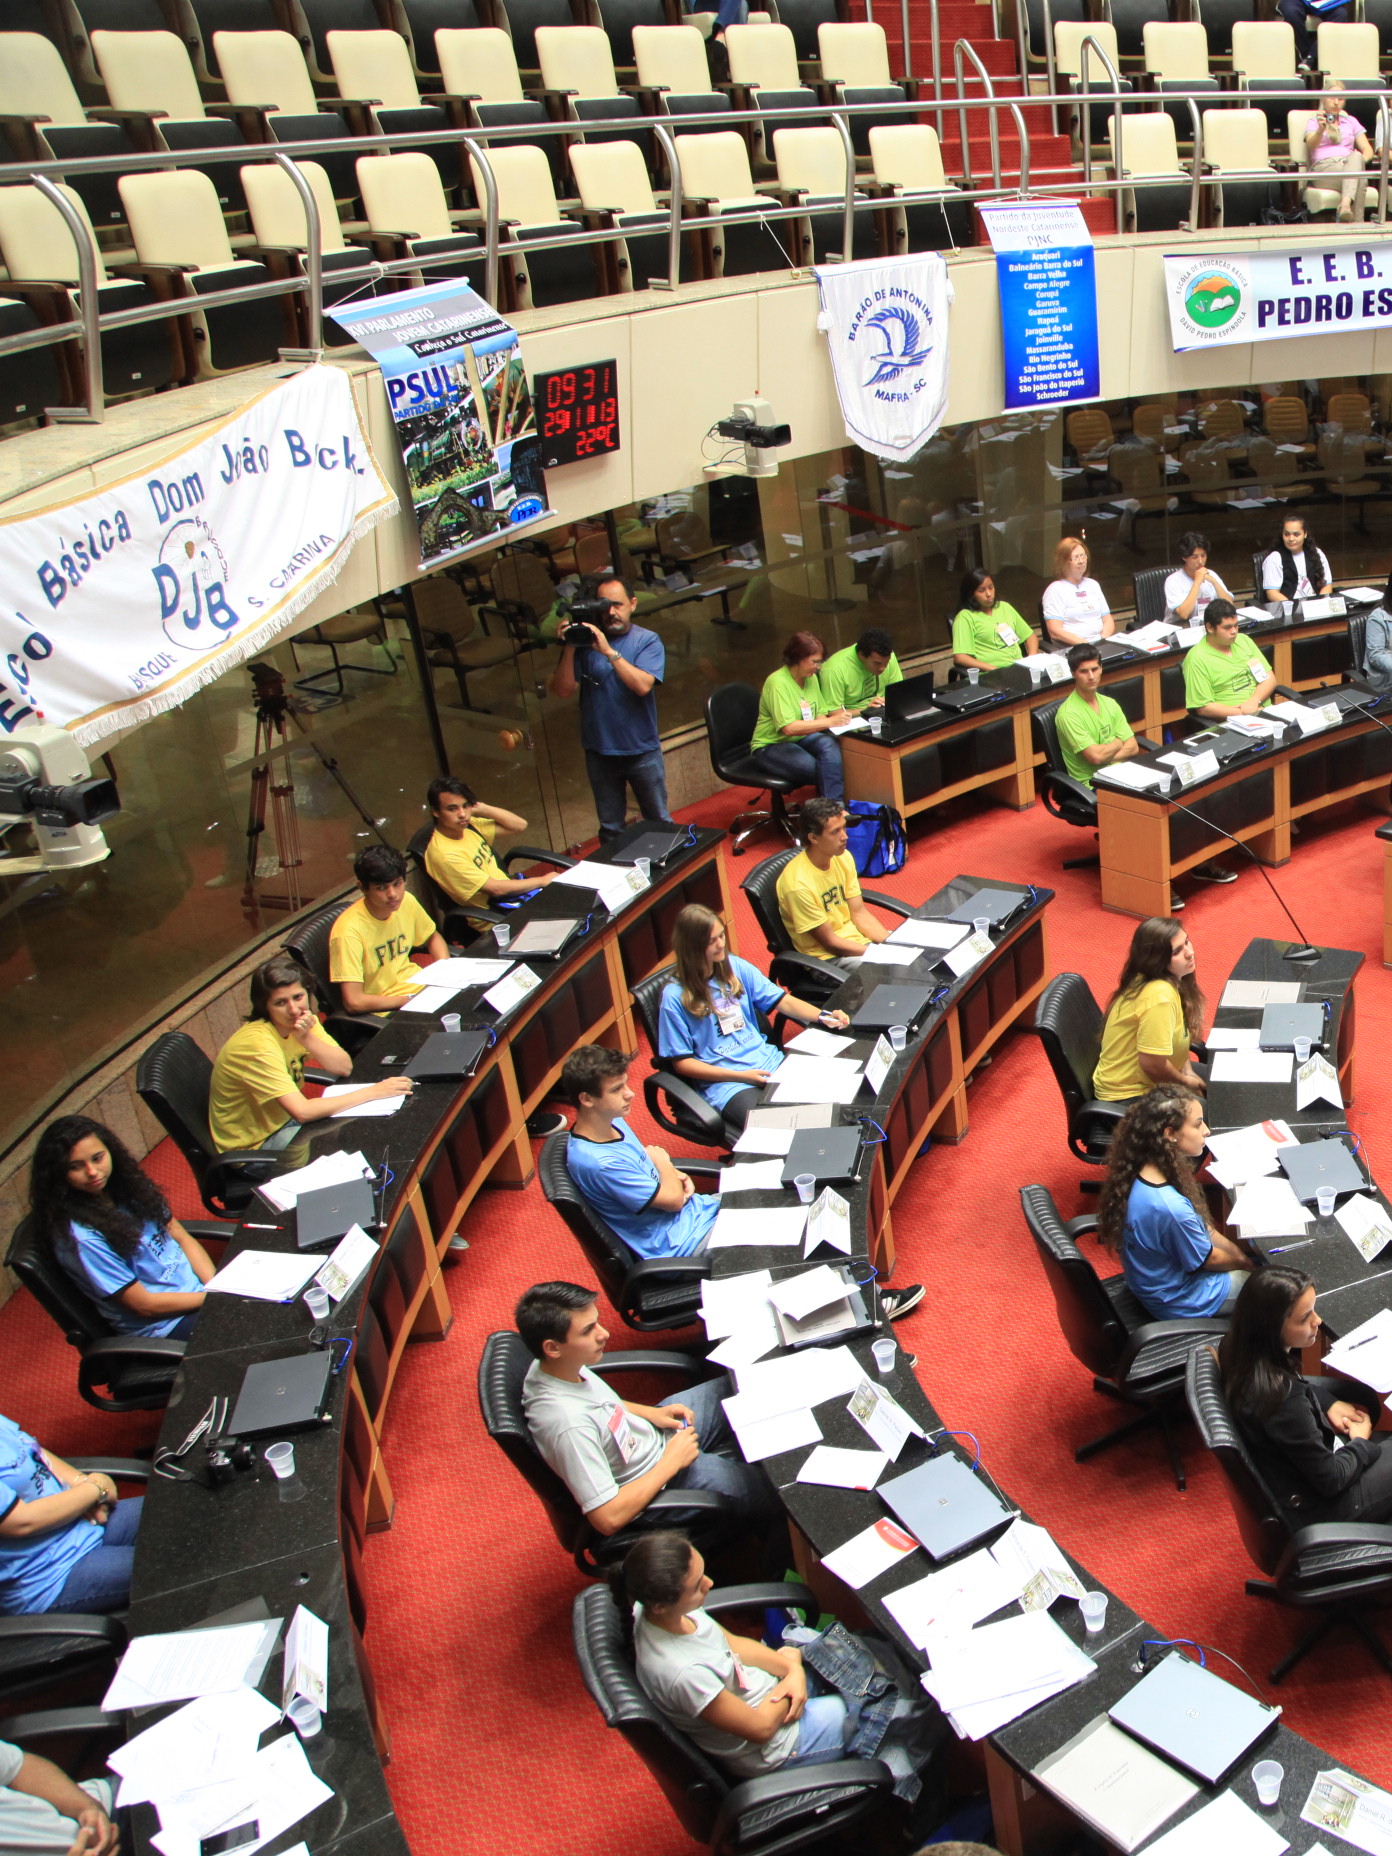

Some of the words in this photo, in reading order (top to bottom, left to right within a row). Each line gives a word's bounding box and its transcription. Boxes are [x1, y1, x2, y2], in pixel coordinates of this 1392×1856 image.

[989, 212, 1019, 222] Partido
[1021, 211, 1031, 220] da
[1033, 210, 1074, 221] Juventude
[992, 224, 1029, 234] Nordeste
[1031, 221, 1079, 232] Catarinense
[1032, 251, 1061, 262] Araquari
[1008, 262, 1043, 272] Balneário
[1043, 261, 1061, 270] Barra
[1062, 260, 1072, 268] do
[1072, 258, 1083, 267] Sul
[1288, 256, 1313, 286] E.
[1322, 253, 1346, 283] E.
[1355, 250, 1383, 279] B.
[1027, 272, 1046, 280] Barra
[1047, 270, 1067, 279] Velha
[1176, 271, 1192, 295] ESCOLA
[1191, 265, 1199, 273] DE
[1199, 259, 1231, 270] EDUCAÇÃO
[1231, 266, 1248, 288] BÁSICA
[1023, 282, 1048, 290] Campo
[1049, 280, 1070, 289] Alegre
[1036, 289, 1059, 299] Corupá
[1027, 306, 1068, 316] Guaramirim
[1036, 300, 1060, 308] Garuva
[1257, 292, 1354, 328] PEDRO
[848, 297, 873, 342] BARÃO
[874, 288, 887, 301] DE
[889, 287, 934, 326] ANTONINA
[1037, 315, 1059, 326] Itapoá
[347, 323, 370, 337] XVI
[366, 307, 435, 334] PARLAMENTO
[392, 326, 431, 343] JOVEM
[427, 307, 494, 334] CATARINENSE
[1179, 317, 1196, 334] DAVID
[1196, 330, 1217, 339] PEDRO
[1025, 326, 1051, 337] Jaraguá
[1052, 324, 1061, 333] do
[1062, 323, 1073, 332] Sul
[1035, 333, 1063, 346] Joinville
[1026, 342, 1074, 354] Massaranduba
[1028, 355, 1040, 364] Rio
[1041, 352, 1072, 363] Negrinho
[1023, 365, 1036, 374] São
[1037, 363, 1057, 372] Bento
[1057, 361, 1067, 370] do
[1067, 359, 1079, 369] Sul
[1018, 375, 1032, 384] São
[1033, 372, 1063, 382] Francisco
[1063, 370, 1073, 378] do
[1073, 368, 1084, 377] Sul
[386, 364, 459, 409] PSUL
[1018, 384, 1032, 393] São
[1032, 382, 1048, 393] João
[1049, 380, 1058, 389] do
[874, 388, 910, 403] MAFRA
[1036, 389, 1069, 400] Schroeder
[394, 402, 431, 419] PARTIDO
[36, 509, 133, 609] Básica
[147, 471, 206, 524] Dom
[151, 562, 240, 631] DJB
[1359, 1803, 1379, 1817] Daniel
